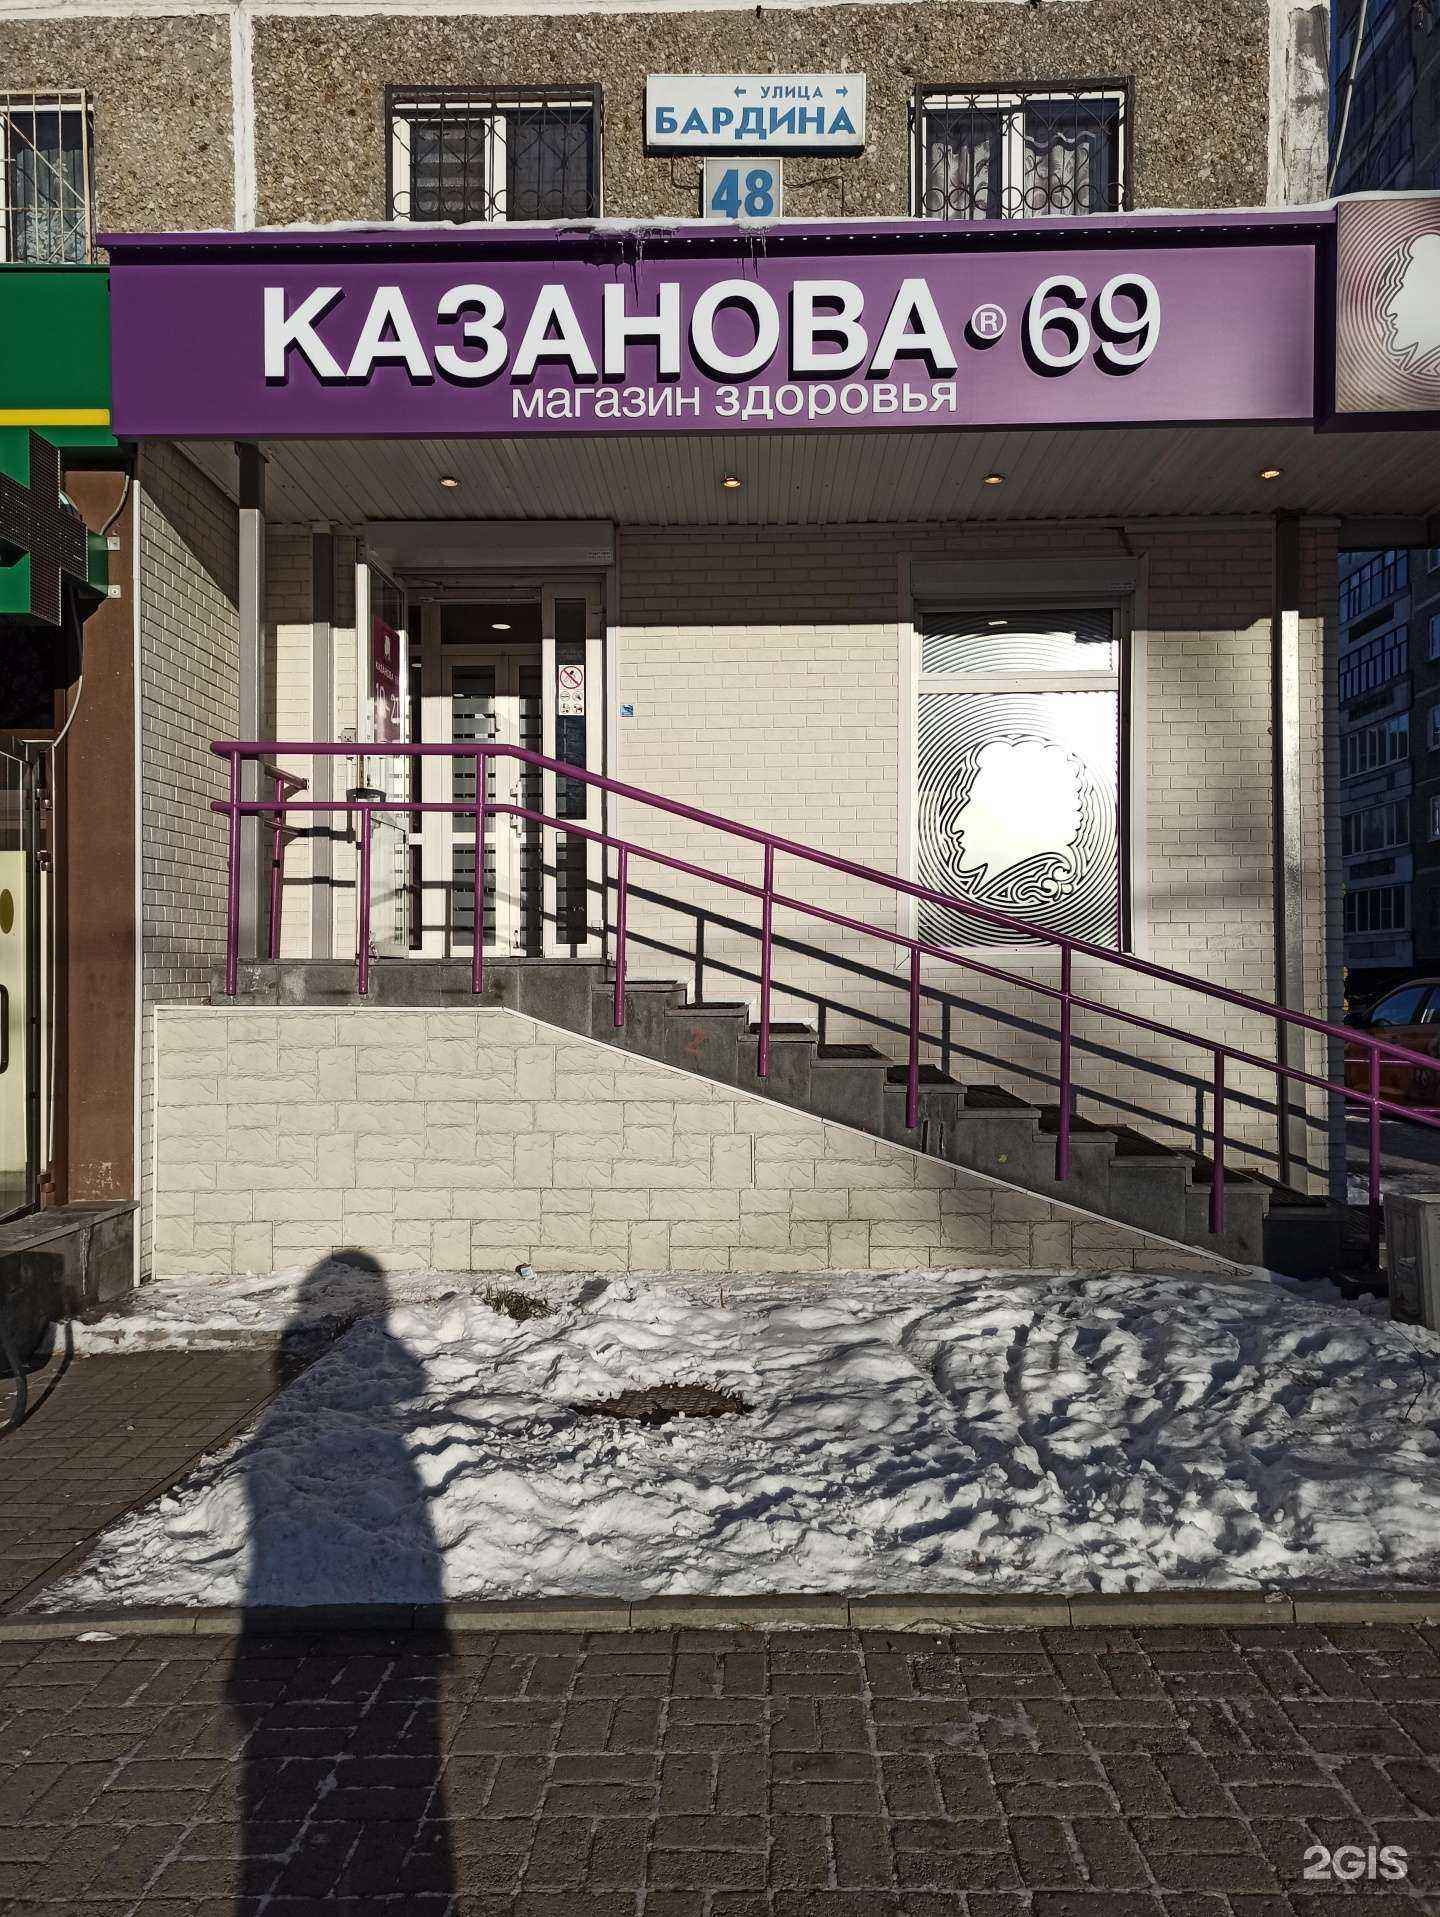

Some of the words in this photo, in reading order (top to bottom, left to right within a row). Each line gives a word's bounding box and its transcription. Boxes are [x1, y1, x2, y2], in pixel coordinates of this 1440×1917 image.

[760, 86, 824, 101] УЛИЦА
[655, 106, 856, 140] БАРДИНА
[711, 169, 774, 218] 48
[263, 278, 958, 382] КАЗАНОВА
[1028, 273, 1161, 369] 69
[511, 386, 701, 419] магазин
[714, 382, 958, 421] здоровья
